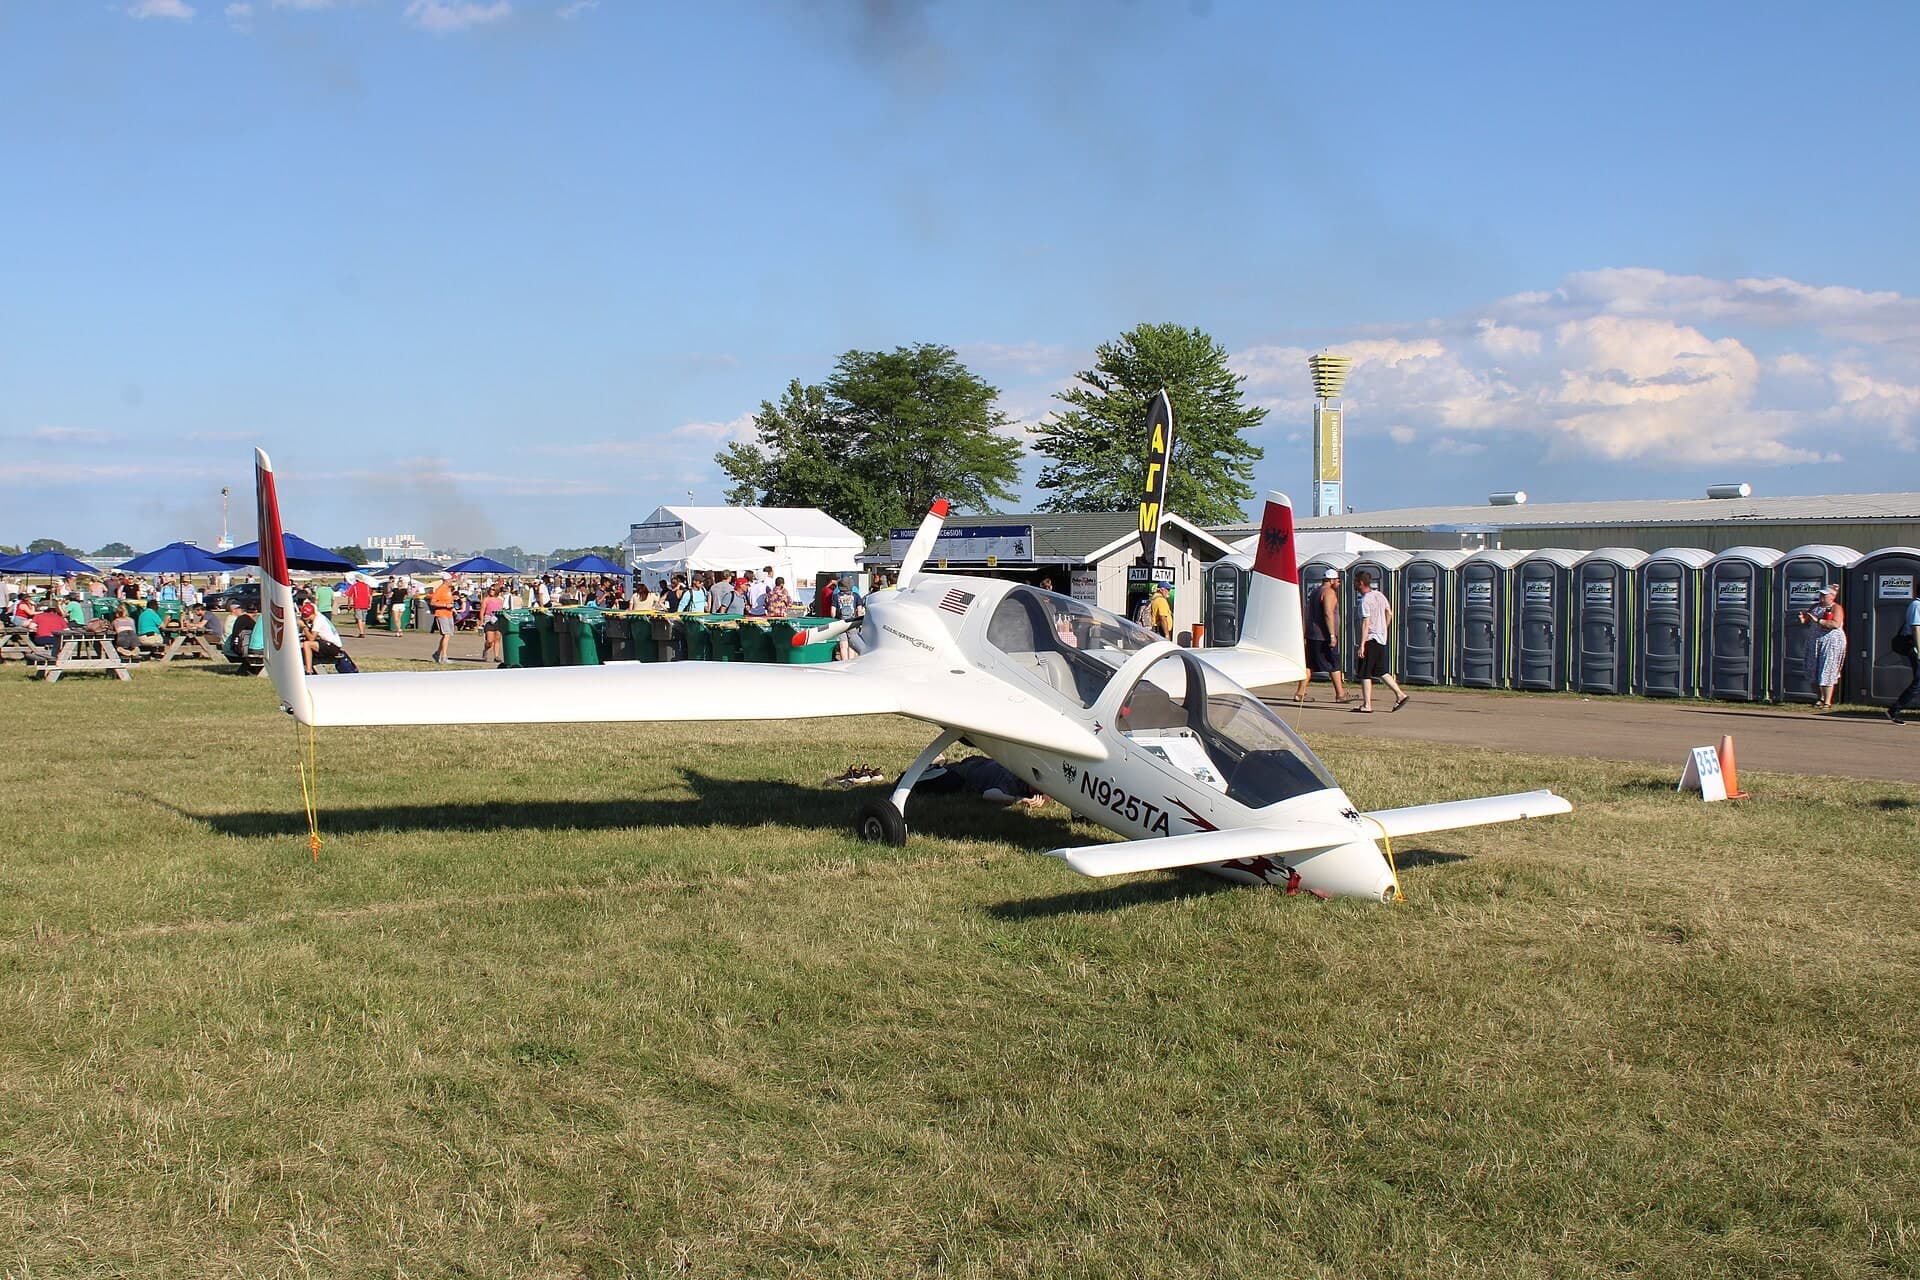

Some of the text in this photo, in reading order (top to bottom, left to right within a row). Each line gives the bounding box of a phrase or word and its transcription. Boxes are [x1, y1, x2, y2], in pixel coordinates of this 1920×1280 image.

[1139, 423, 1164, 532] ATM
[1131, 569, 1146, 579] ATM
[1154, 570, 1171, 580] ATM
[1696, 749, 1720, 776] 355
[1080, 770, 1170, 837] N925TA
